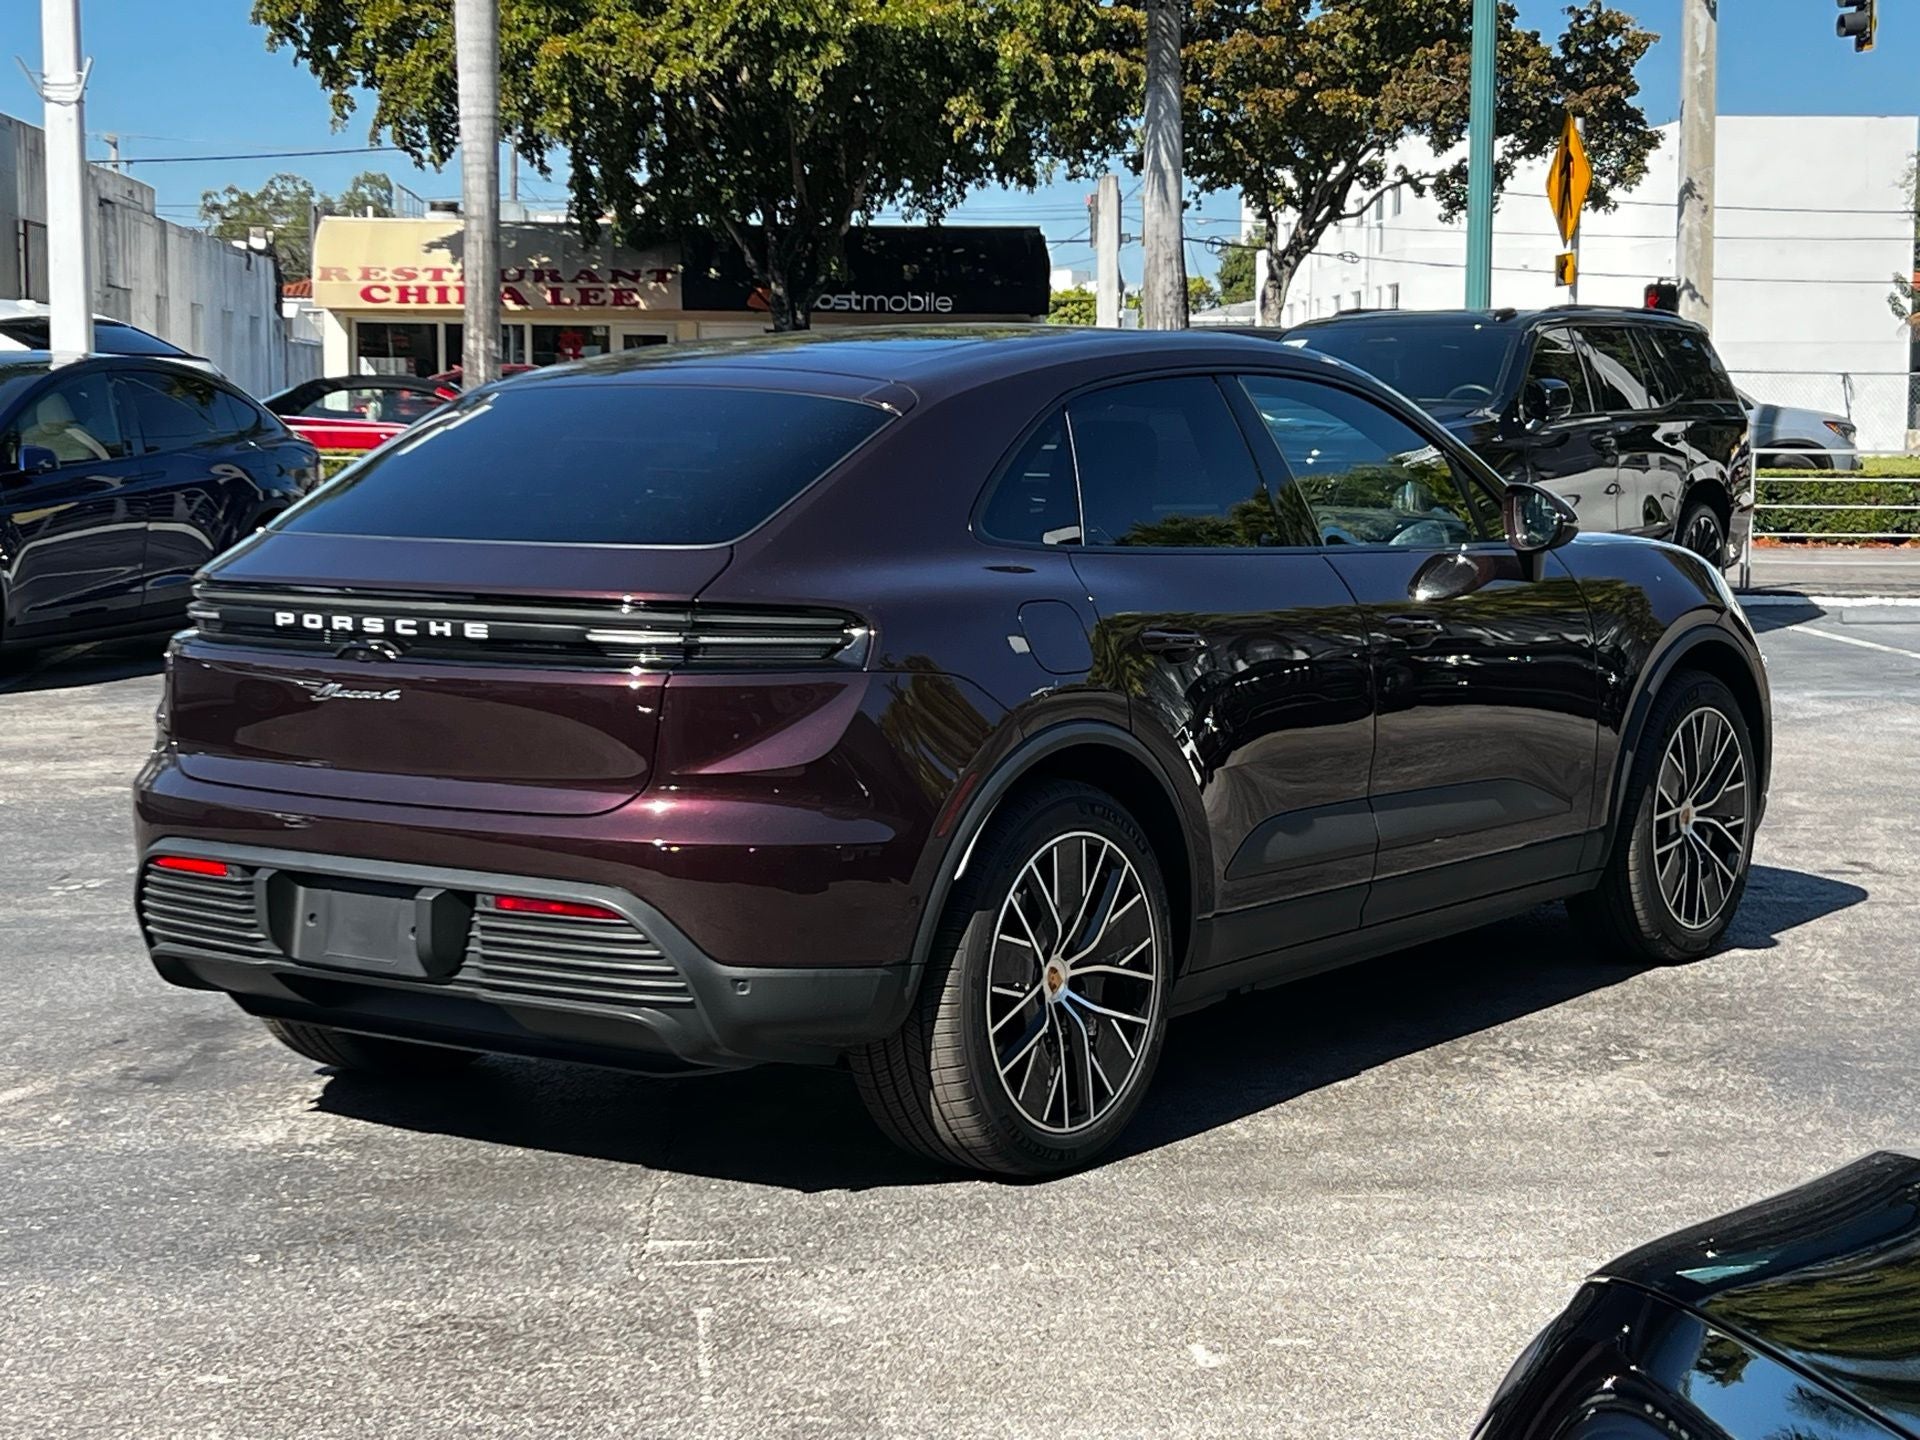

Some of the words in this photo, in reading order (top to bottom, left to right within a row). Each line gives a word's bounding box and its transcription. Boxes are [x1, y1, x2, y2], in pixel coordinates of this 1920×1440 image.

[318, 265, 678, 283] RESTURANT
[359, 284, 530, 307] CHIA
[546, 286, 642, 307] LEE
[274, 610, 490, 640] PORSCHE
